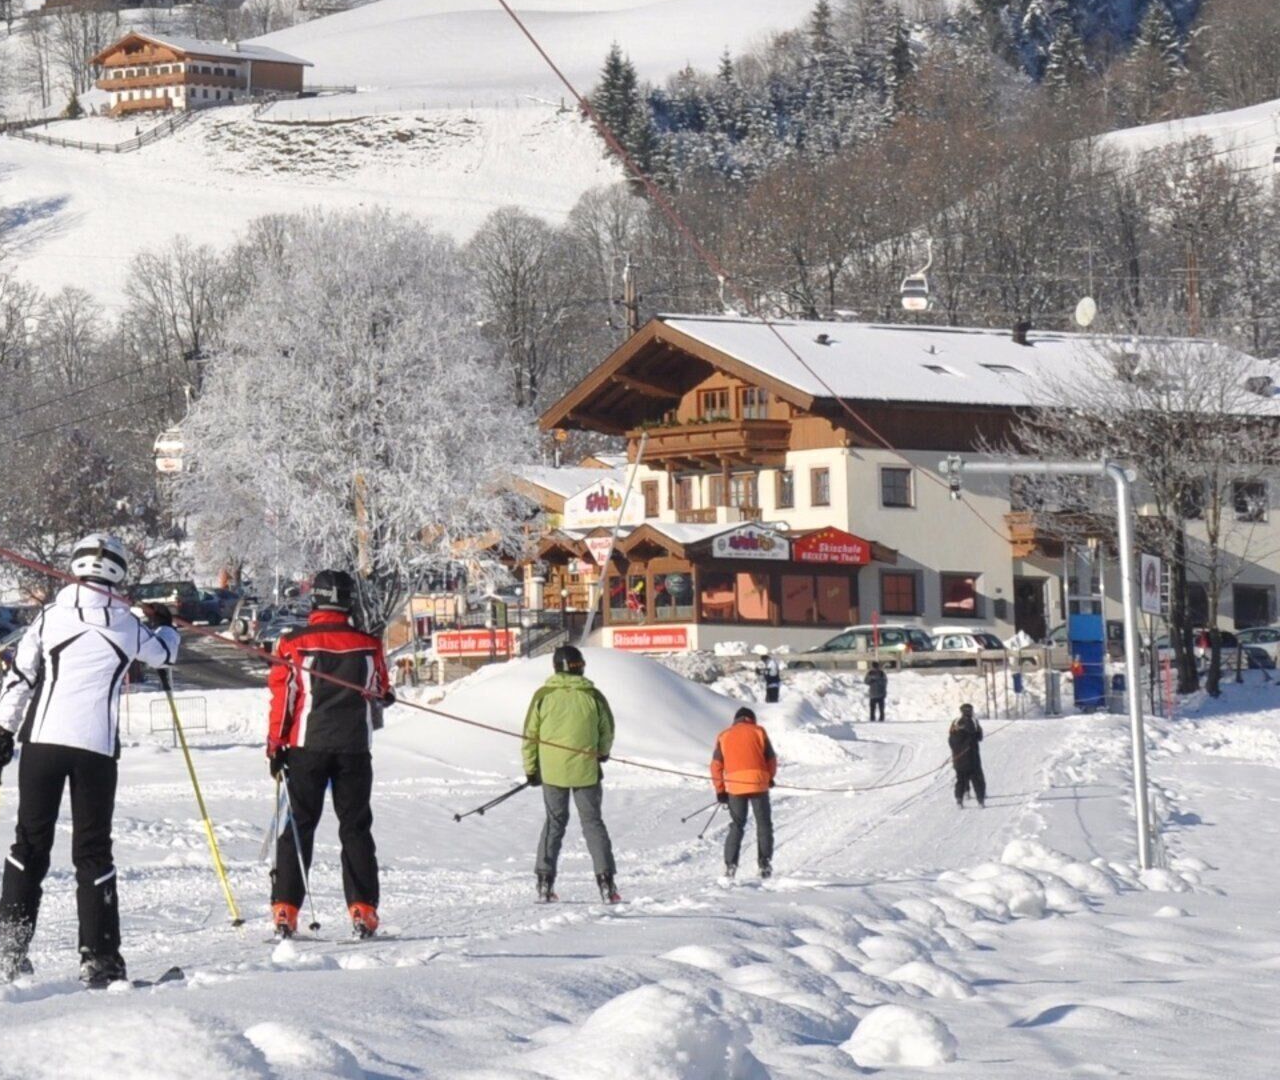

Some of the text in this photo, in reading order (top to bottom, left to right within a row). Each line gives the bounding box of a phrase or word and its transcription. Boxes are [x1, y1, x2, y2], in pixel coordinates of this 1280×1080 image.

[819, 542, 861, 553] Skischule
[802, 551, 828, 561] BRIXEN
[614, 633, 651, 646] Skischule
